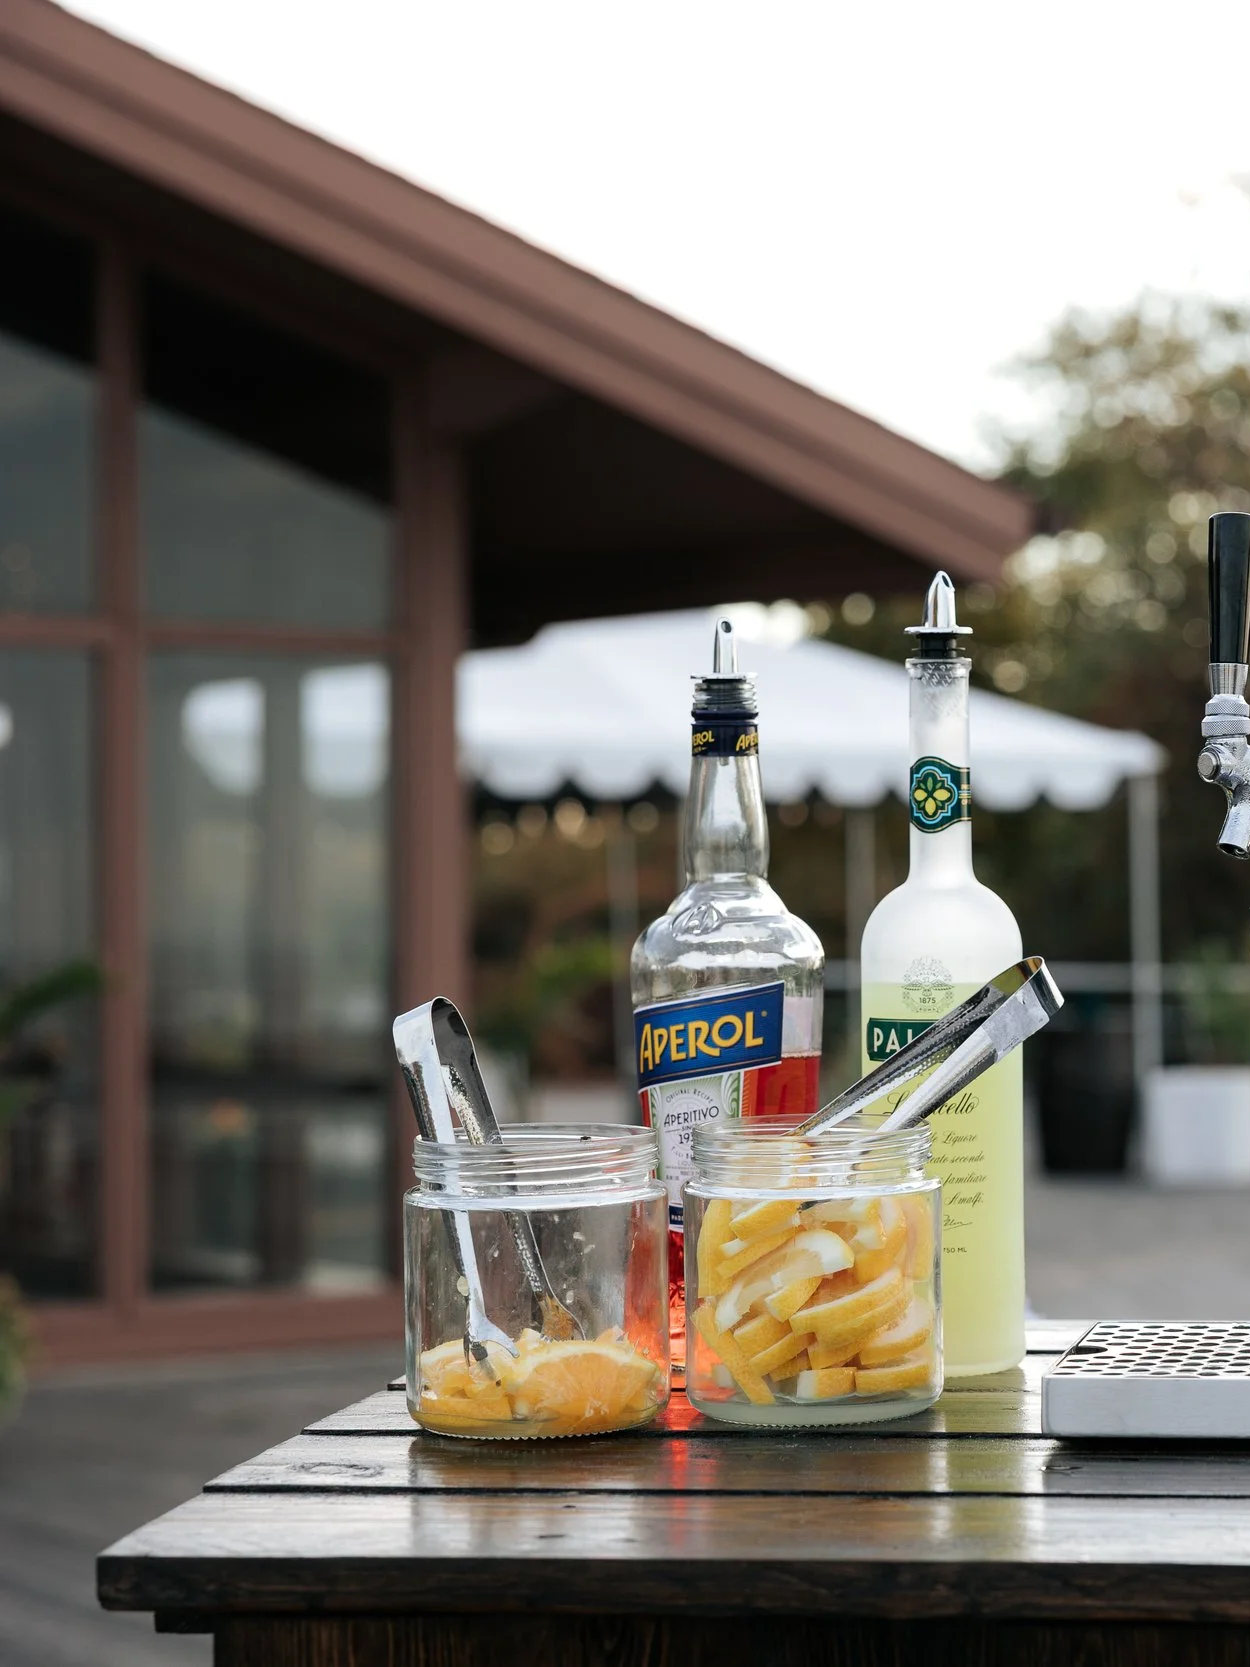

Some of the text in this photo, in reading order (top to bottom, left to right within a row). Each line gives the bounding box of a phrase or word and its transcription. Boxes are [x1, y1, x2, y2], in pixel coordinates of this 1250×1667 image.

[693, 730, 715, 746] EROL
[735, 733, 758, 751] APE
[640, 1010, 764, 1074] APEROL
[883, 1090, 980, 1115] Lcello
[663, 1105, 719, 1128] APERITIVO
[679, 1132, 690, 1145] 19
